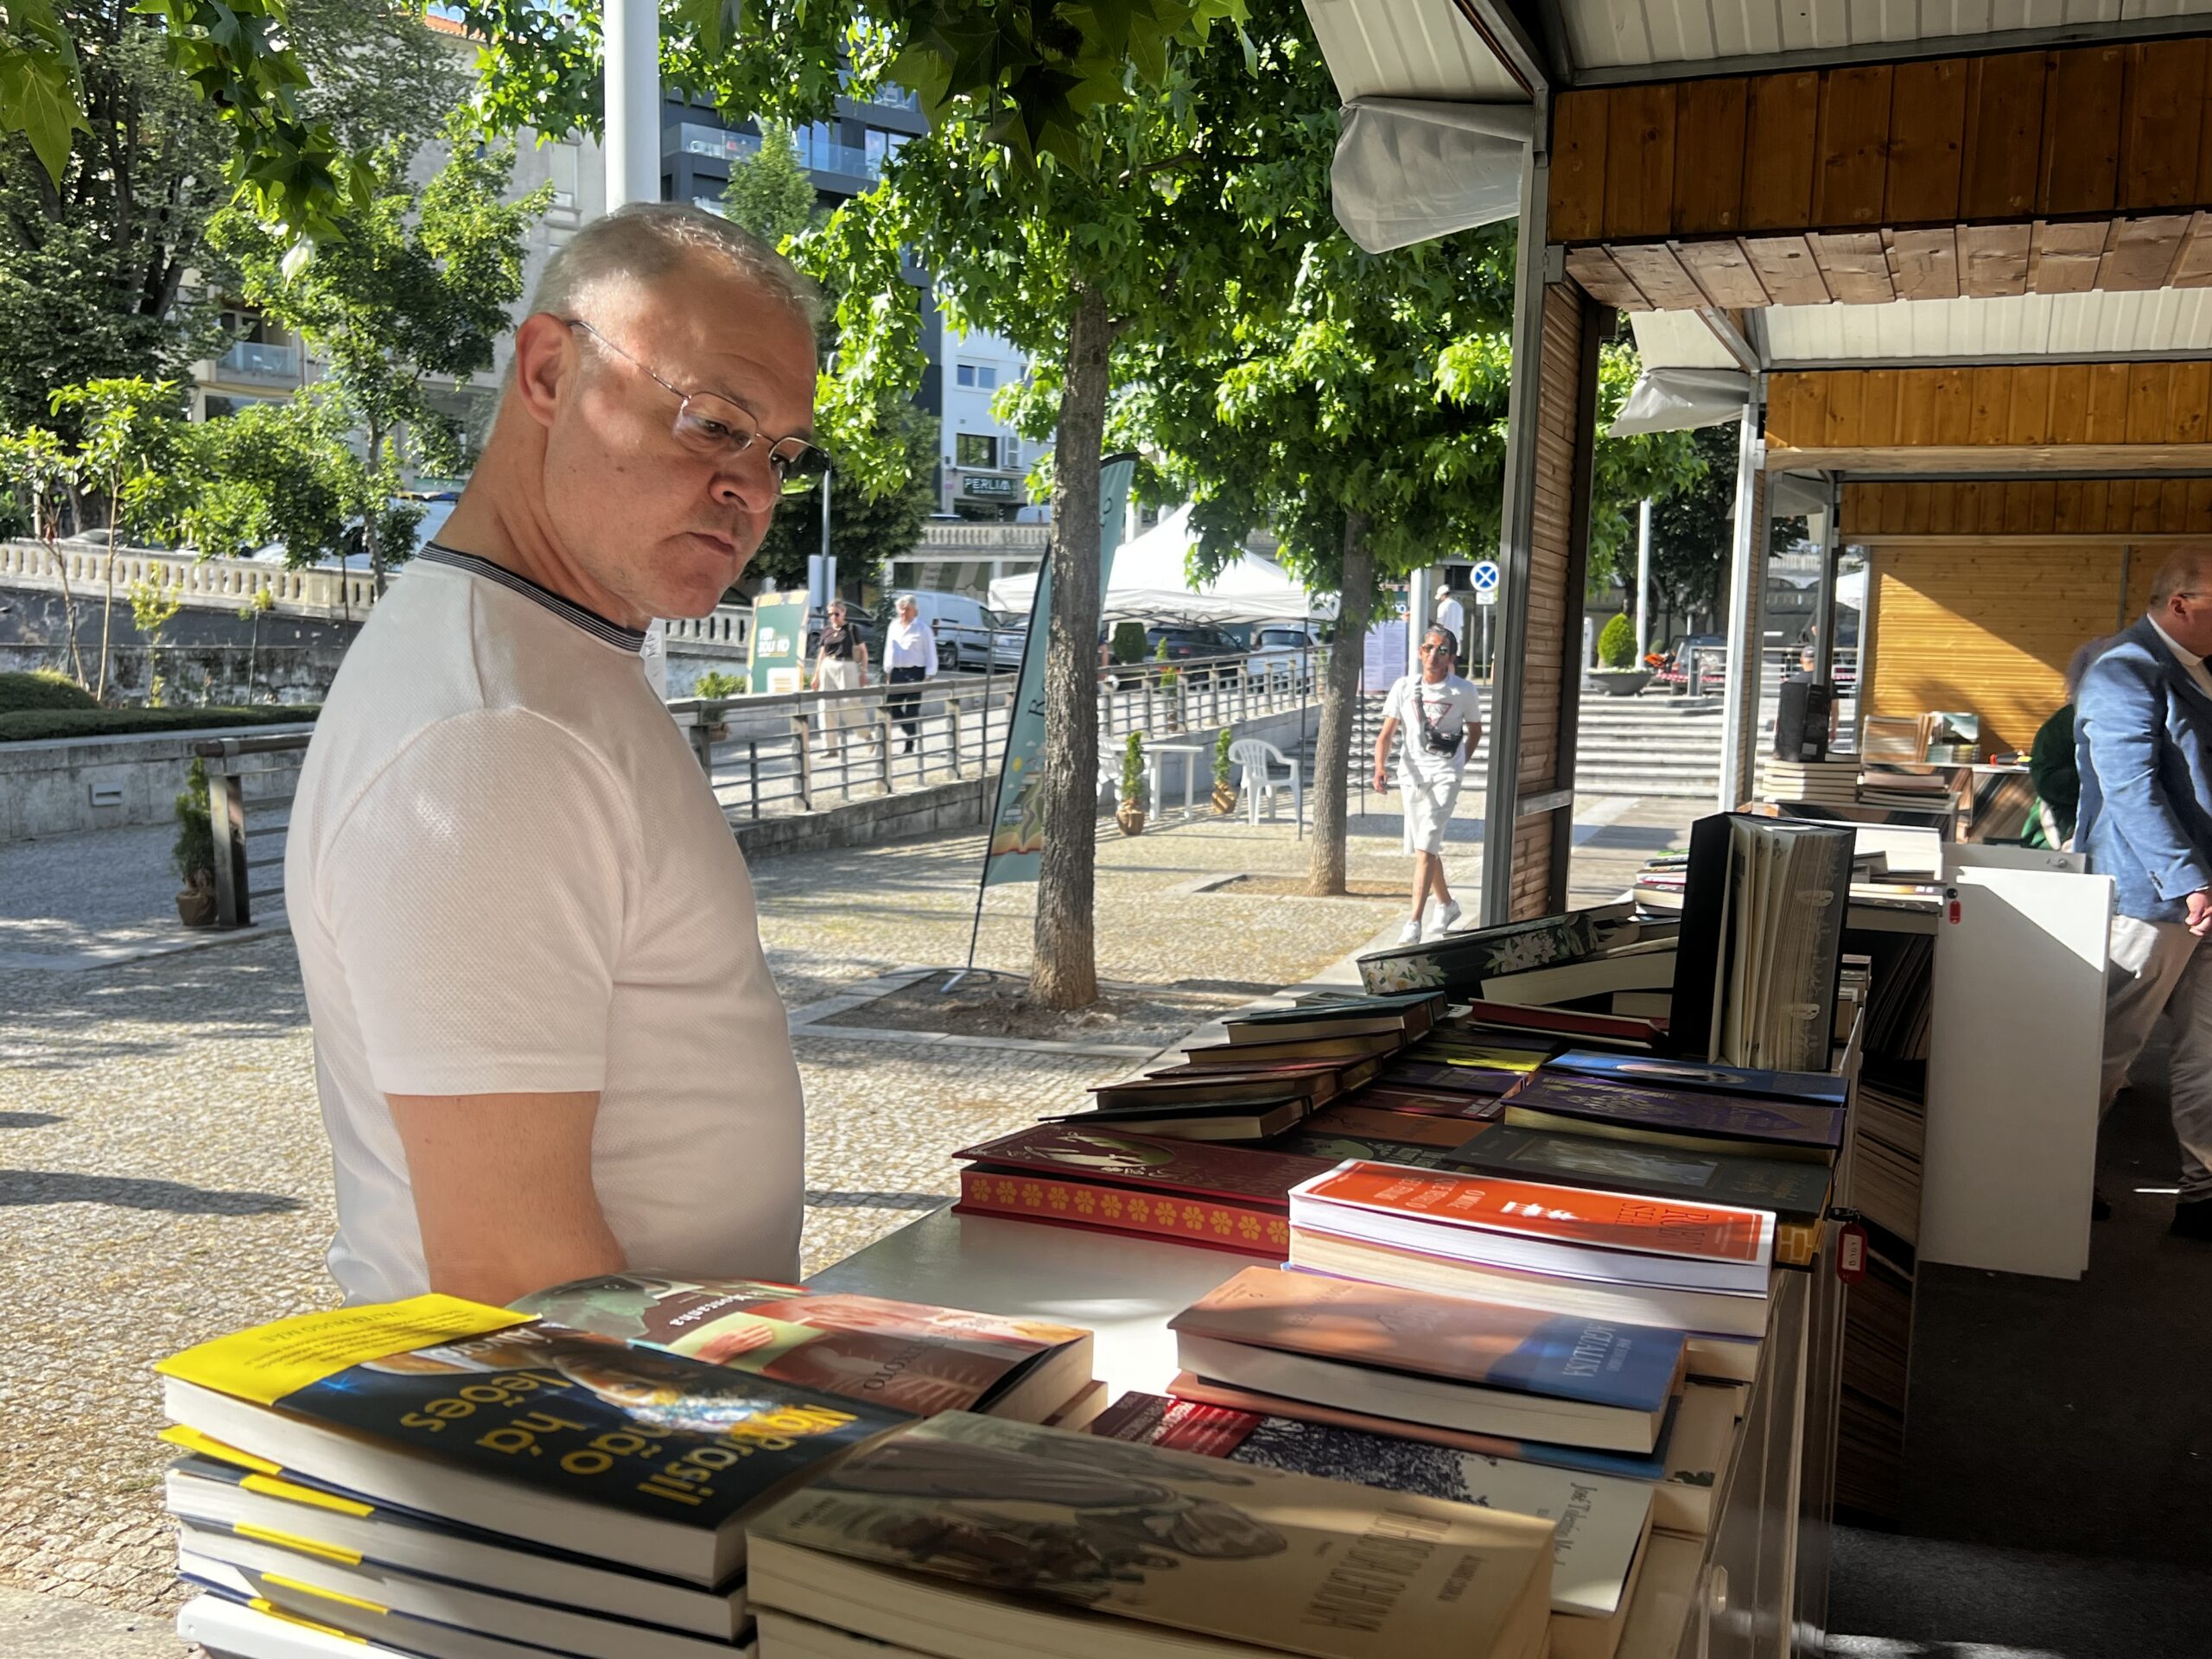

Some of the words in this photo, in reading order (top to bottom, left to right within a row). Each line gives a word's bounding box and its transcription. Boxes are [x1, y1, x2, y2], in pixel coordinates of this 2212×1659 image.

[1561, 1321, 1617, 1378] AGUALUSA
[399, 1370, 573, 1433] leões
[474, 1410, 587, 1457] há
[559, 1420, 672, 1477] não
[637, 1433, 796, 1506] Brasil
